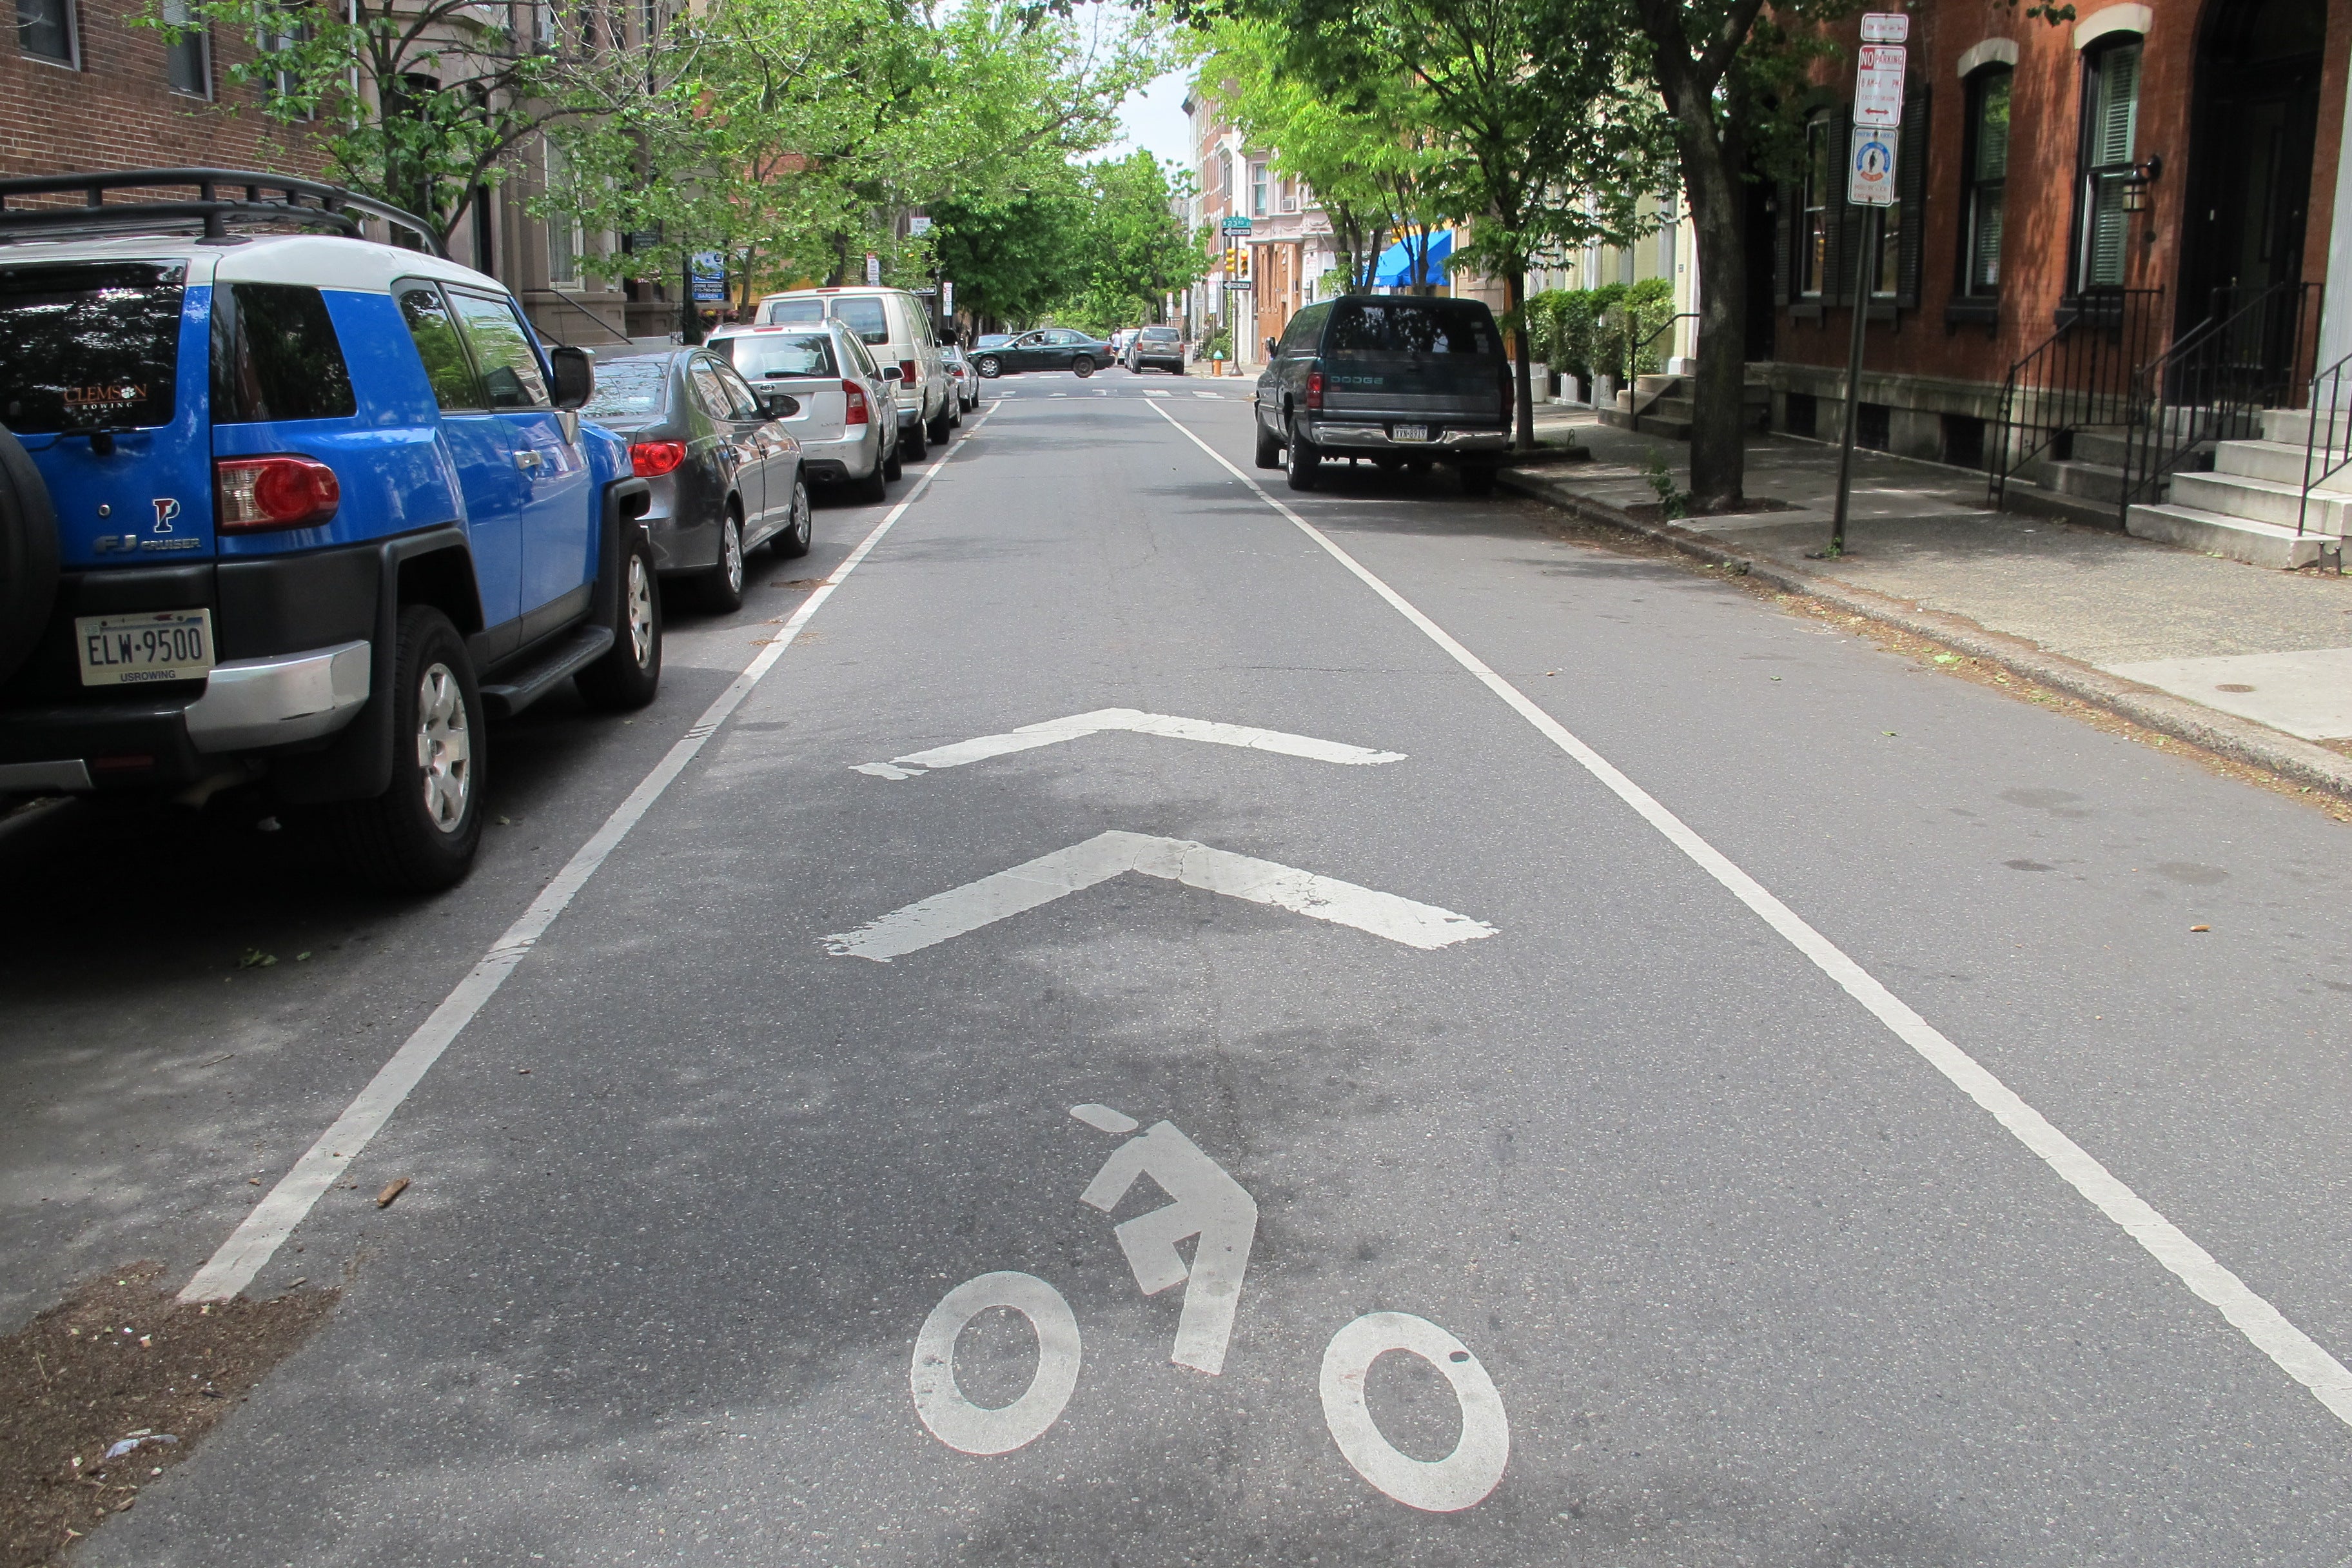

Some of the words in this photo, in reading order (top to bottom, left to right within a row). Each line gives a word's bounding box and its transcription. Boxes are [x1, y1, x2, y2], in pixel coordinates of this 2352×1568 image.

[1861, 52, 1874, 66] NO
[1876, 54, 1903, 65] PARKING
[1330, 375, 1384, 385] DODGE
[83, 402, 133, 410] ROWING
[94, 534, 137, 554] FJ
[141, 538, 202, 551] CRUISER
[120, 669, 176, 682] USROWING
